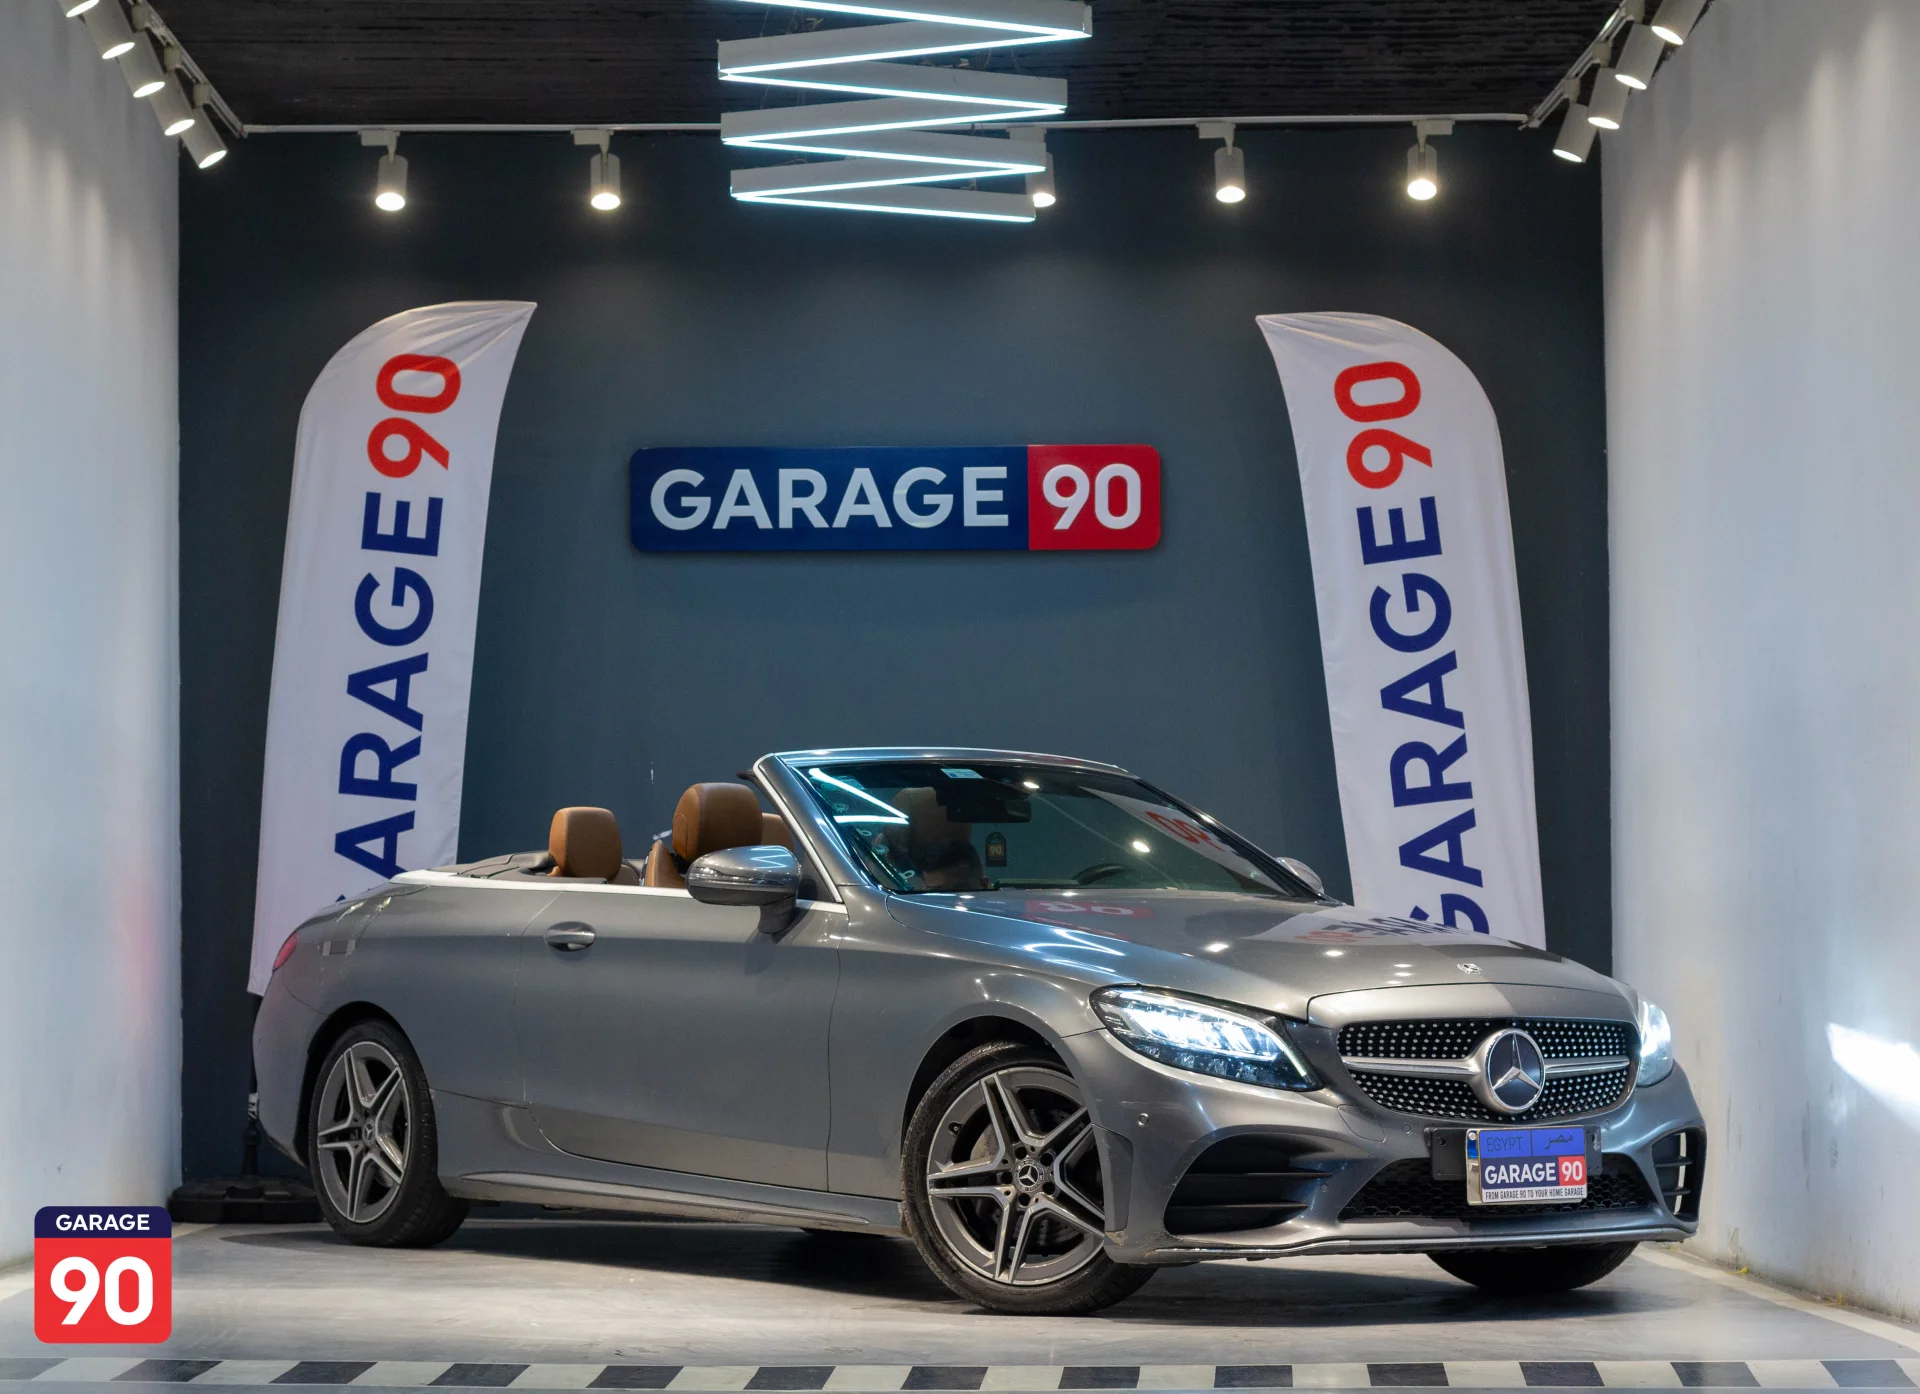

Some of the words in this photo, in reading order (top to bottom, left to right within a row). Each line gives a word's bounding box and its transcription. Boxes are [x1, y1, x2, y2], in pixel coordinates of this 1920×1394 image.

[650, 467, 1009, 530] GARAGE
[1042, 463, 1141, 530] 90
[1486, 1136, 1524, 1153] EGYPT
[1543, 1133, 1573, 1150] مصر
[1484, 1162, 1557, 1185] GARAGE
[1561, 1160, 1583, 1182] 90
[1485, 1191, 1499, 1200] FROM
[1500, 1190, 1519, 1200] GARAGE
[1519, 1190, 1527, 1199] 90
[1528, 1189, 1534, 1198] TO
[1535, 1188, 1548, 1198] YOUR
[1549, 1187, 1563, 1197] HOME
[1564, 1186, 1584, 1197] GARAGE
